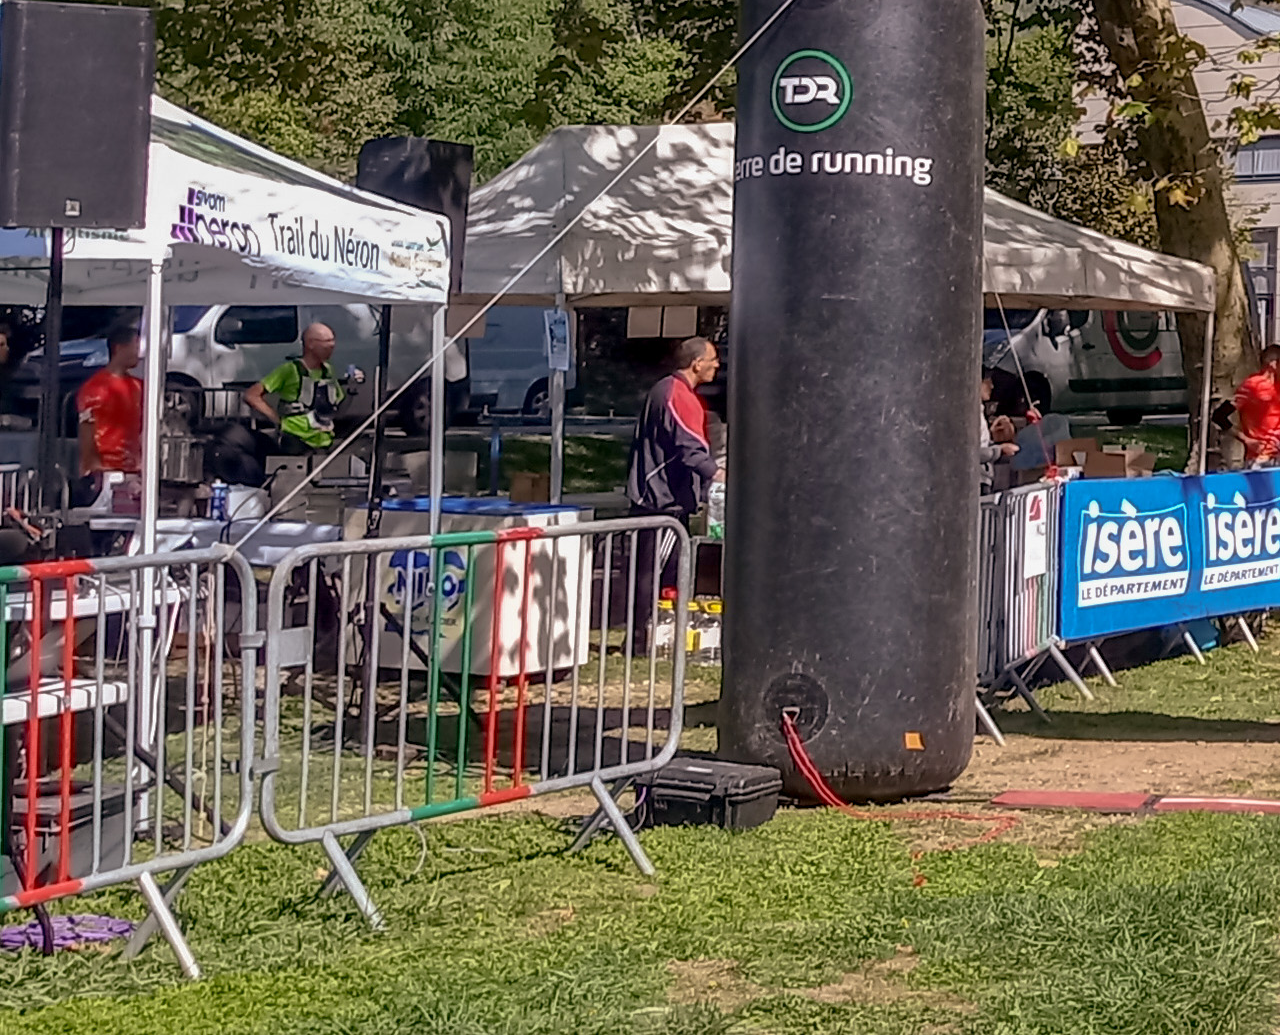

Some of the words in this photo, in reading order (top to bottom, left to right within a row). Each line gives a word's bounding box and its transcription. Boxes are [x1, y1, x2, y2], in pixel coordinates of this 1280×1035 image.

[779, 75, 841, 105] TDR
[735, 155, 764, 182] erre
[769, 146, 803, 175] de
[811, 146, 933, 186] running
[267, 213, 305, 255] Trail
[309, 219, 330, 261] du
[334, 225, 380, 271] Néron
[1083, 498, 1184, 574] isère
[1081, 586, 1092, 600] LE
[1095, 577, 1185, 599] DÉPARTEMENT
[1204, 573, 1216, 585] LE
[1217, 564, 1279, 583] DÉPARTEMENT
